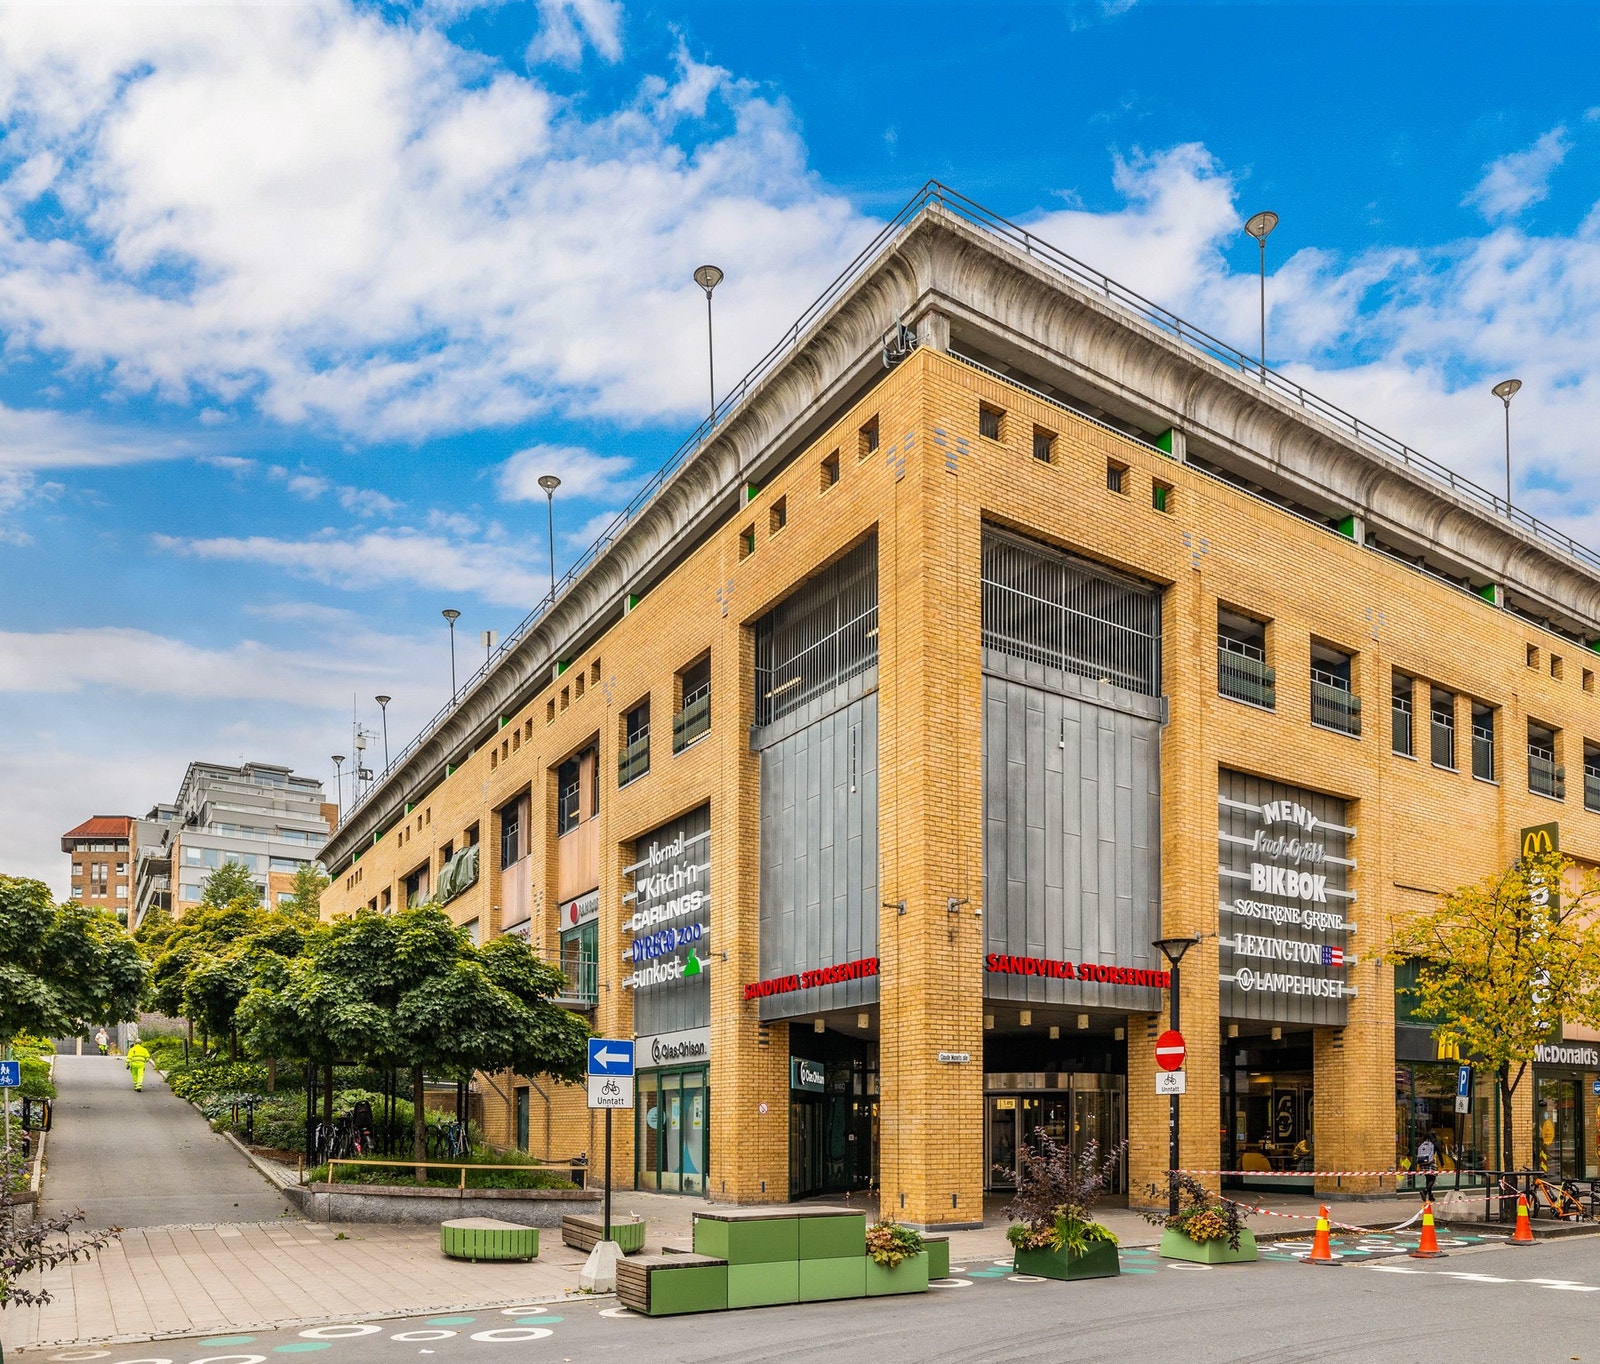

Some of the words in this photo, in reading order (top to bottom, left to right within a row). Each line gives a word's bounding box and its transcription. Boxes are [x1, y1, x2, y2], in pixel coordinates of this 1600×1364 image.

[1262, 800, 1318, 832] MENY
[649, 831, 684, 868] Normal
[1252, 829, 1289, 859] Krogh
[632, 890, 703, 932] CARLINGS
[1234, 899, 1300, 925] SØSTRENE
[1302, 909, 1343, 931] GRENE
[633, 928, 677, 963] DYREGO
[1234, 933, 1322, 965] LEXINGTON
[633, 956, 681, 989] sunkost
[744, 974, 799, 1000] SANDVIKA
[801, 957, 878, 989] STORSENTER
[986, 953, 1076, 980] SANDVIKA
[1078, 963, 1171, 988] STORSENTER
[1255, 972, 1344, 999] LAMPEHUSET
[1533, 1044, 1599, 1065] McDonald's
[1460, 1070, 1467, 1092] P
[597, 1096, 624, 1105] Unntatt
